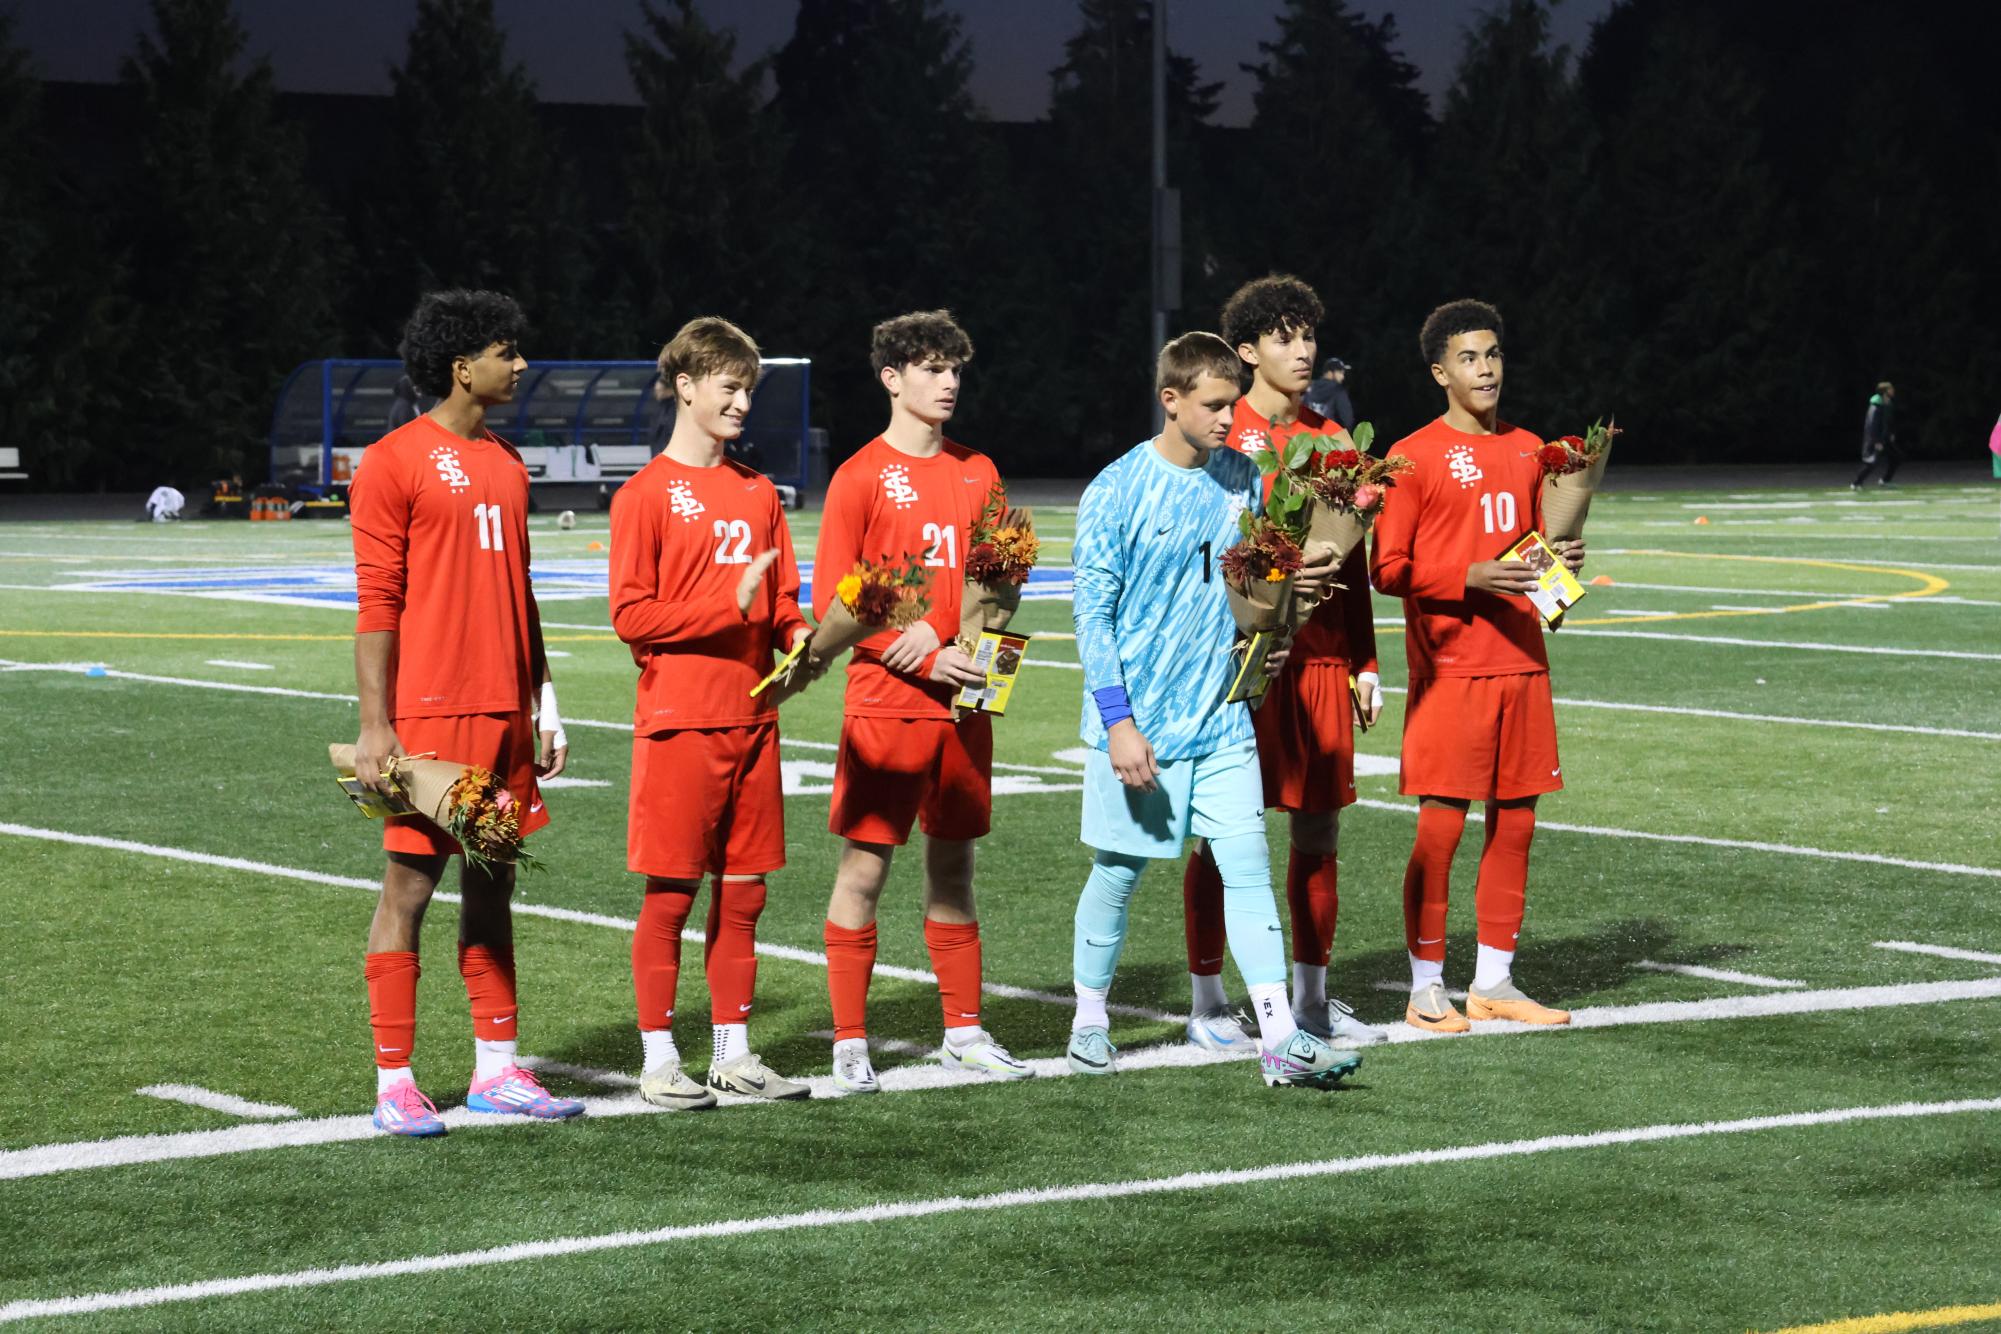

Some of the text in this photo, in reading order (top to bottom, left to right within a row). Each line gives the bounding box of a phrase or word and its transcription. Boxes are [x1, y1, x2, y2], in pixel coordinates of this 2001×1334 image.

[473, 503, 504, 551] 11
[1480, 491, 1516, 534] 10
[713, 519, 753, 564] 22
[922, 522, 956, 569] 21
[1198, 540, 1211, 583] 1
[1263, 997, 1274, 1019] EX
